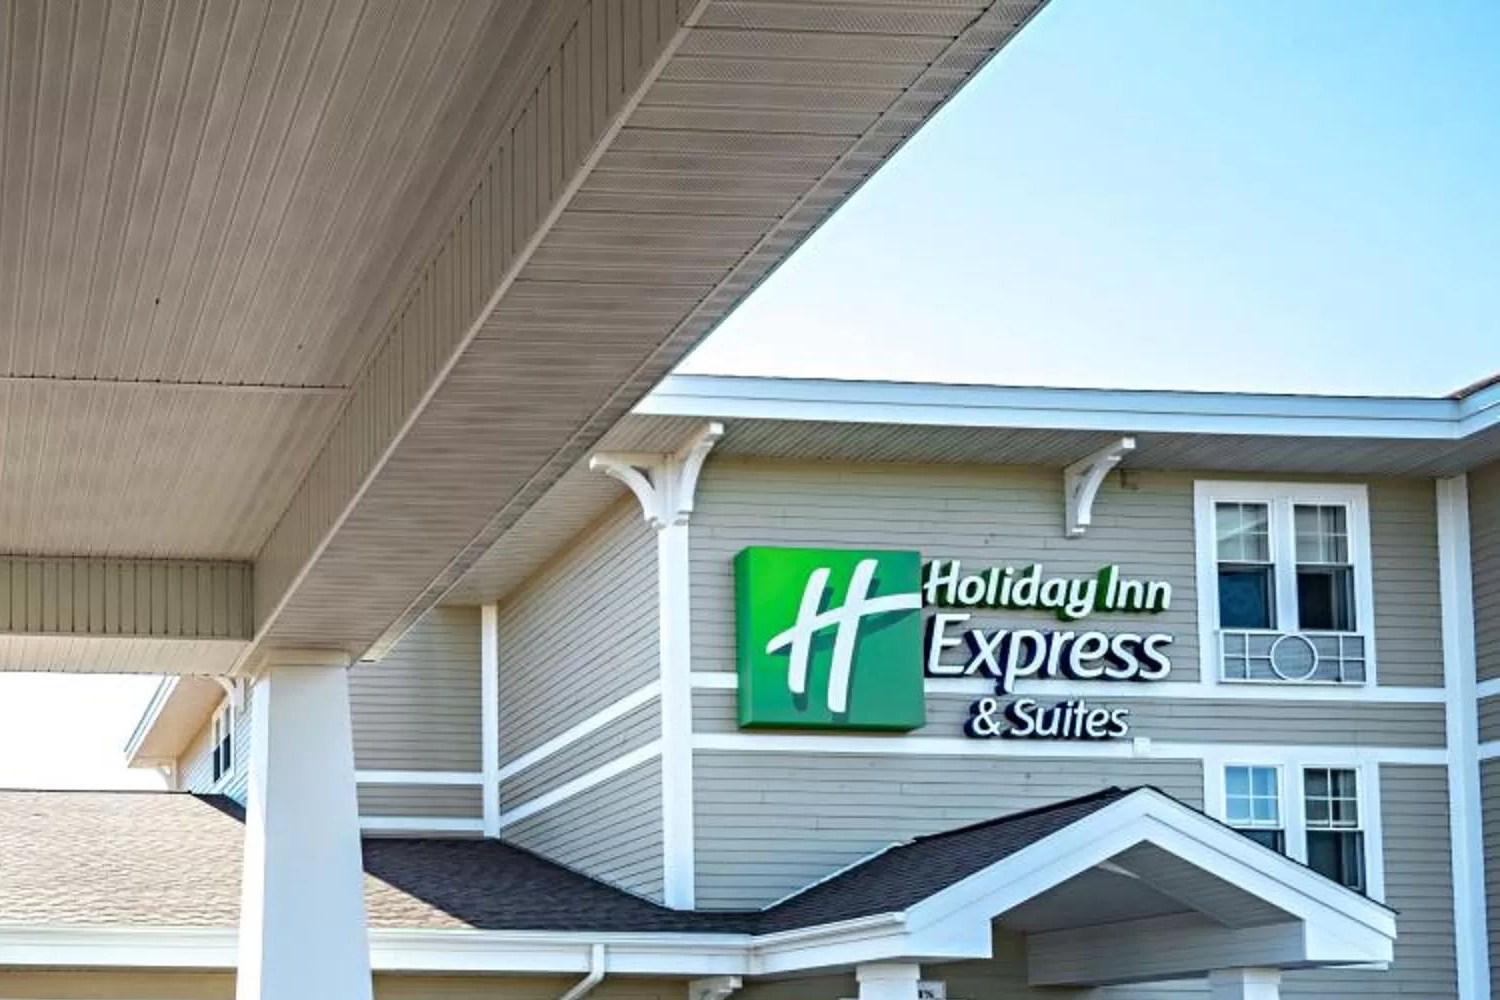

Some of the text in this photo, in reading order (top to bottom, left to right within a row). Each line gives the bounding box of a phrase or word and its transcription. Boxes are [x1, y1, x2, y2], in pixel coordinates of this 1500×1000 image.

[923, 559, 1172, 620] Holiday Inn
[926, 612, 1173, 694] Express
[970, 697, 1130, 738] & Suites
